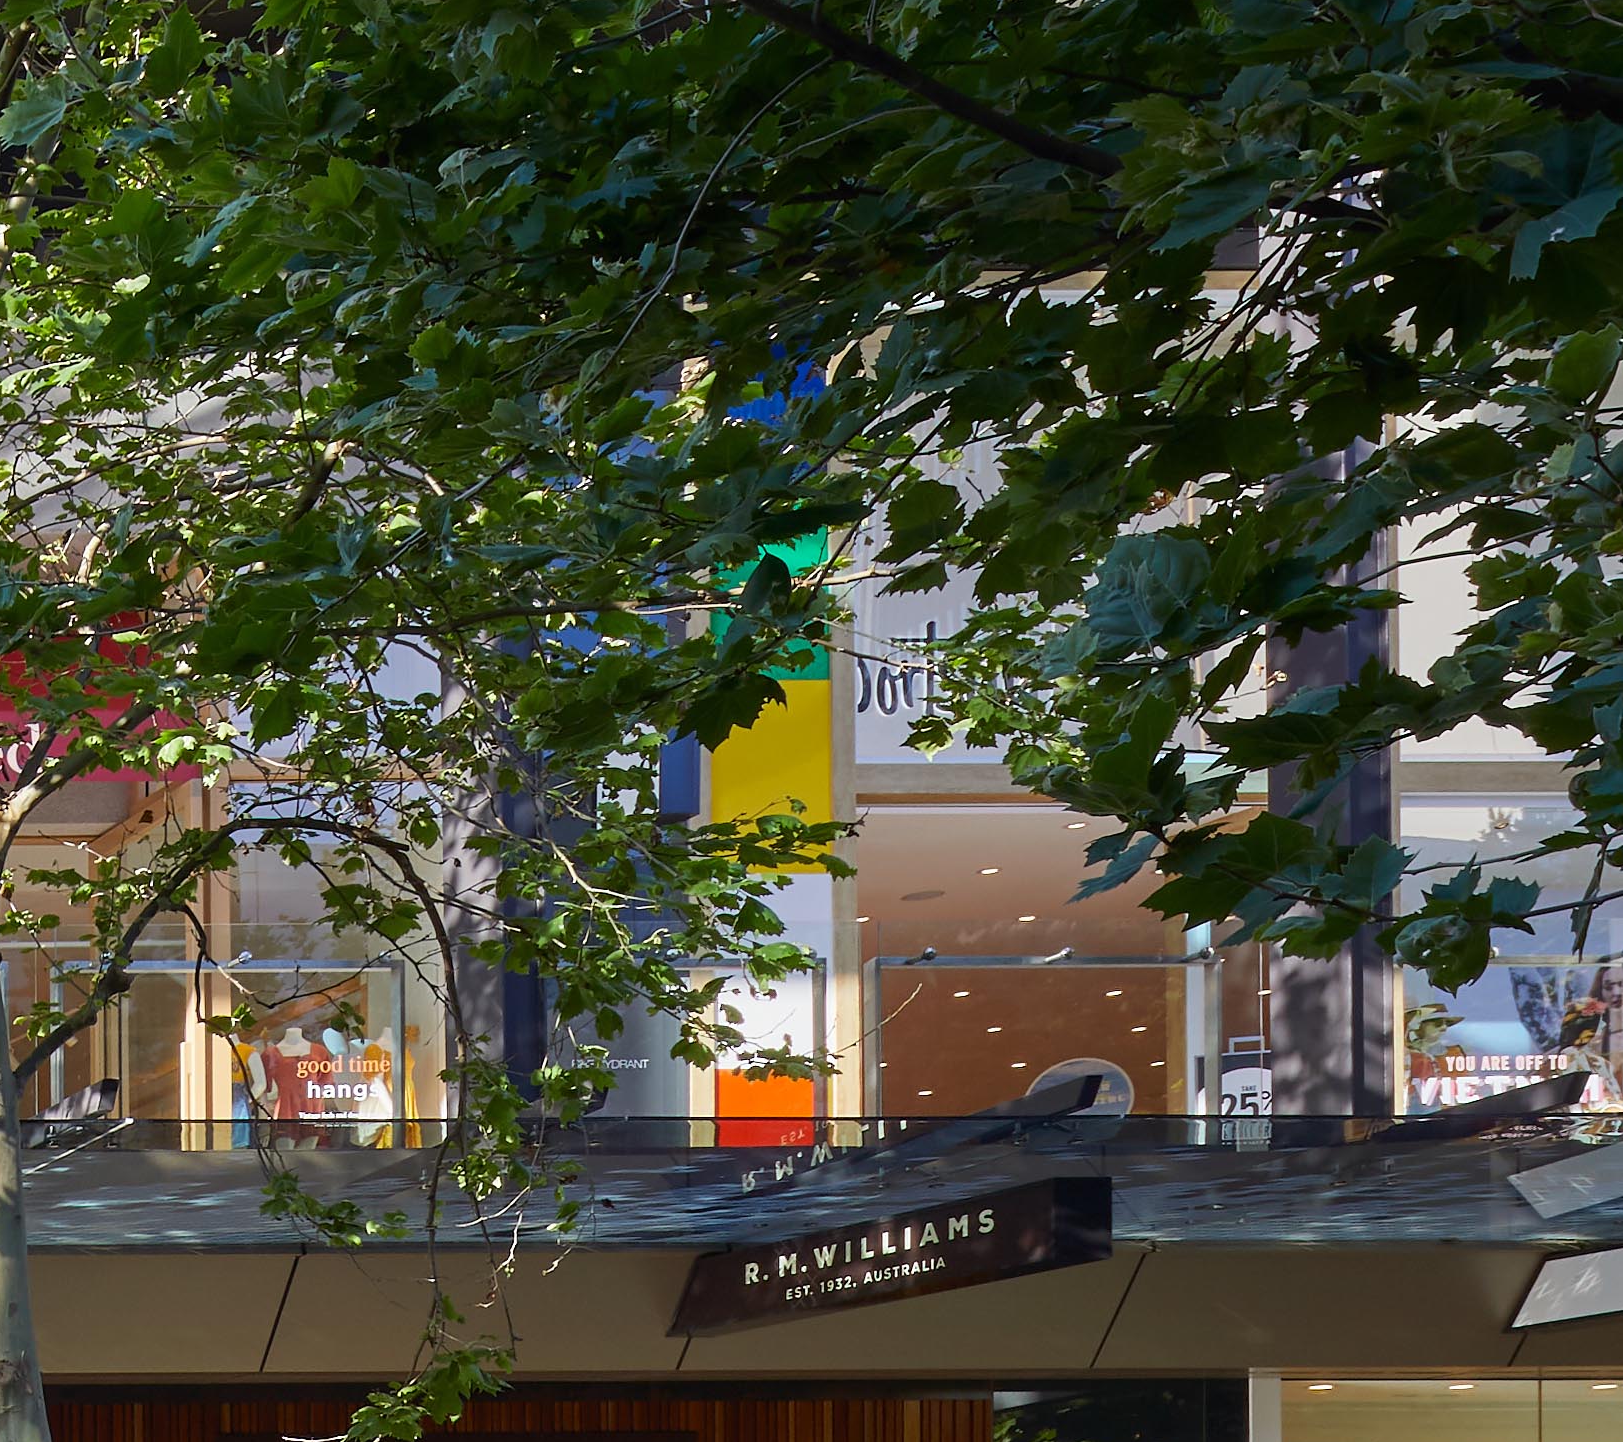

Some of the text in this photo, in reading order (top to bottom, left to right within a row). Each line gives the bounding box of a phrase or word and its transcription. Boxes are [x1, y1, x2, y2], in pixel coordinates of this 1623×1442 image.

[297, 1055, 391, 1078] good time
[602, 1059, 649, 1069] YDRANT
[1445, 1054, 1568, 1072] YOU ARE OFF TO
[307, 1080, 379, 1102] hangs
[813, 1209, 995, 1269] WILLIAMS
[785, 1285, 814, 1300] EST.
[863, 1257, 947, 1285] AUSTRALIA
